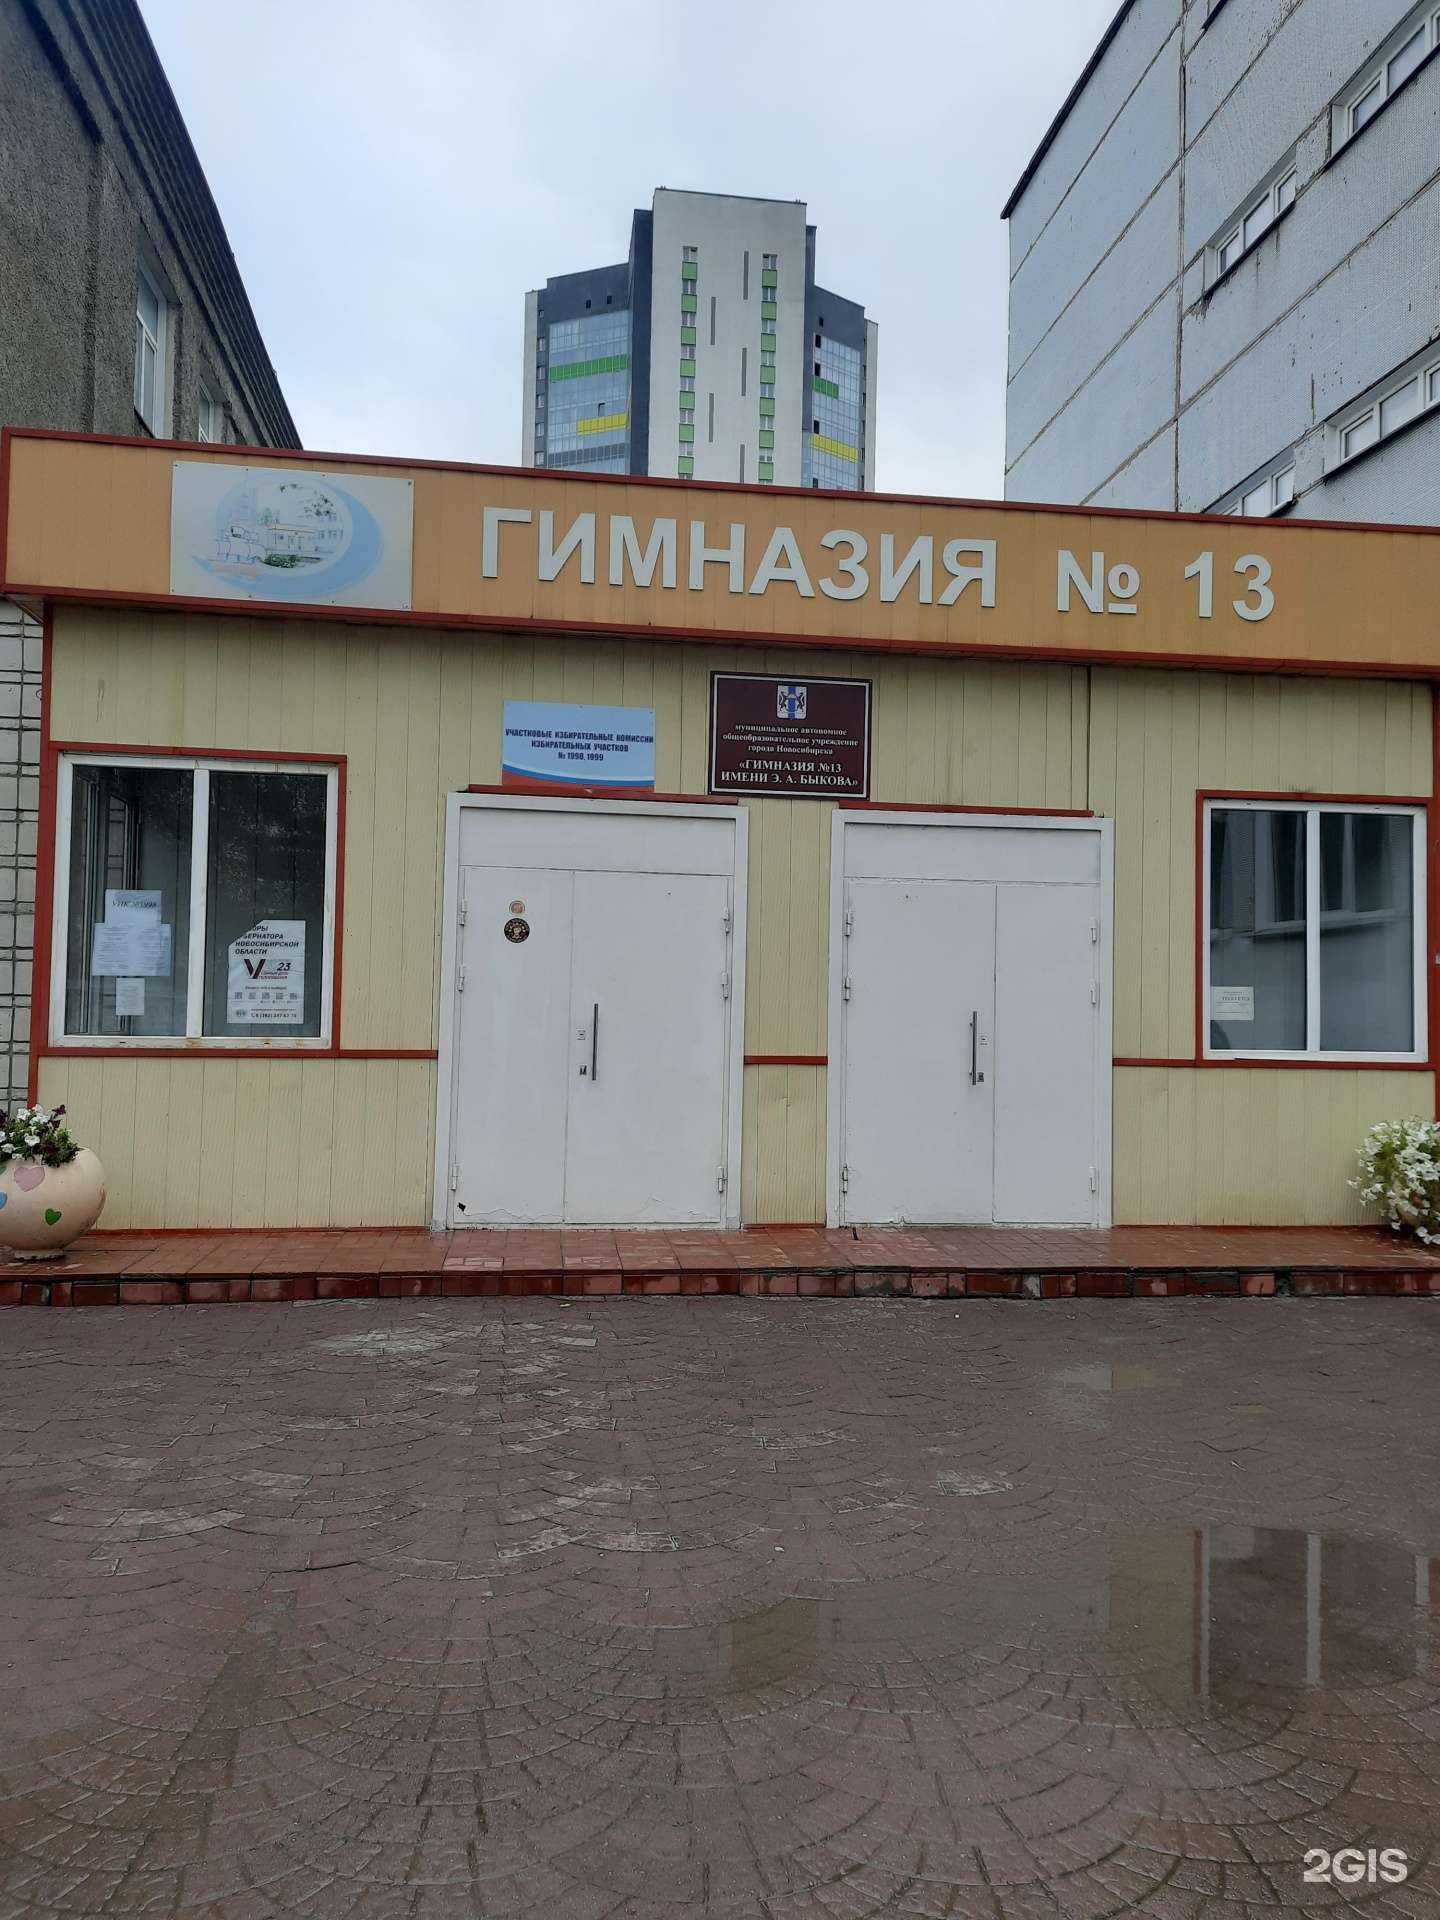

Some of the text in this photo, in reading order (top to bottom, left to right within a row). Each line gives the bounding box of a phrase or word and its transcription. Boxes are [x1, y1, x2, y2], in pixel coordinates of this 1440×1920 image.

[481, 506, 1275, 622] ГИМНАЗИЯ № 13
[505, 728, 654, 743] УЧАСТКОВЫЕ ИЗБИРАТЕЛЬНЫЕ КОМИССИИ
[735, 724, 848, 736] муниципальное автономное
[531, 740, 629, 752] ИЗБИРАТЕЛЬНЫХ УЧАСТКОВ
[723, 733, 859, 747] общеобразовательное учреждение
[748, 745, 833, 756] города Новосибирска
[587, 753, 604, 761] 1999
[739, 760, 842, 773] «ГИМНАЗИЯ №13
[721, 771, 858, 786] ИМЕНИ Э. А. БЫКОВА»
[277, 963, 291, 971] 23
